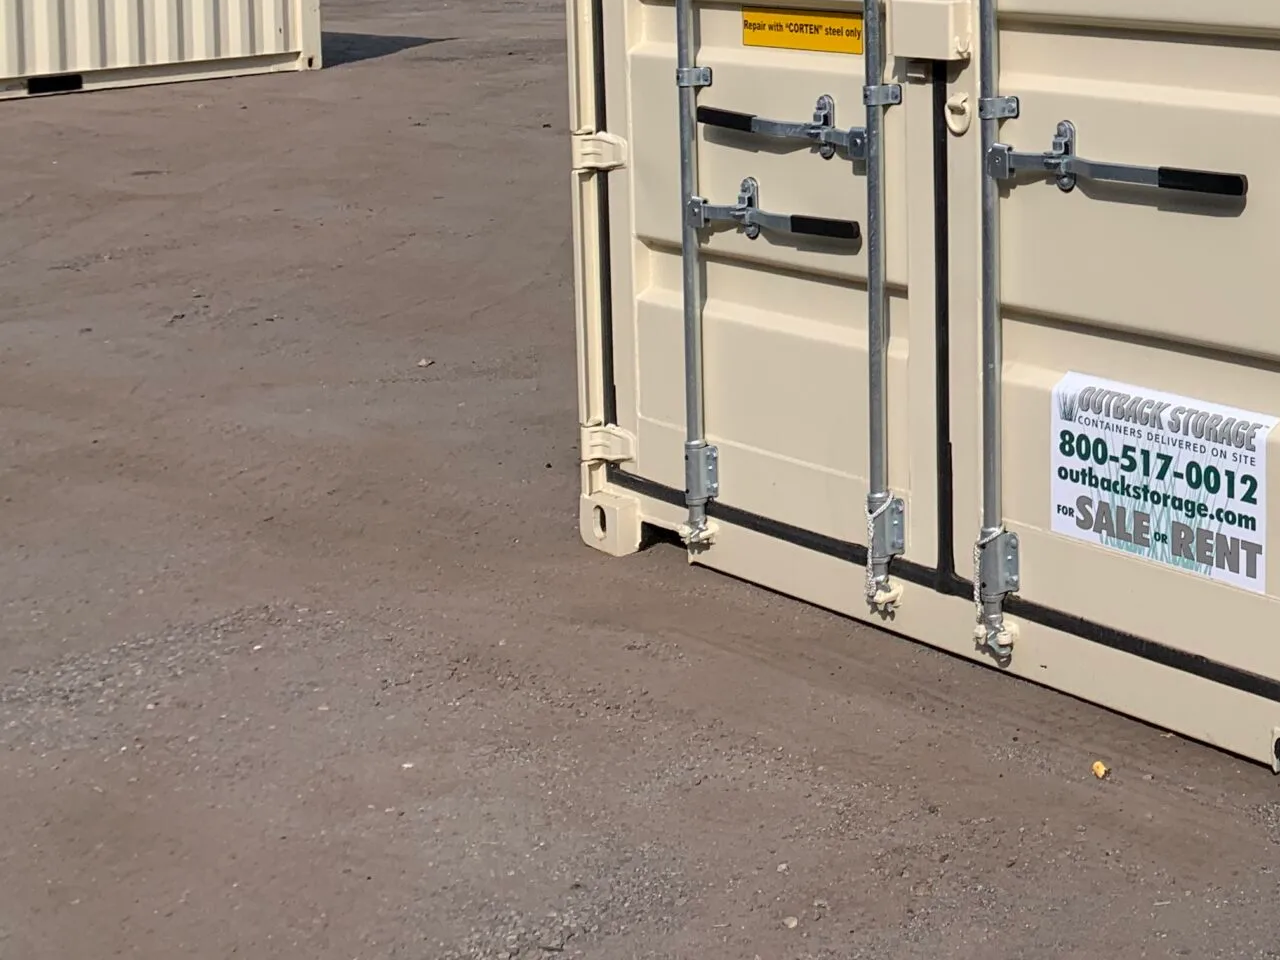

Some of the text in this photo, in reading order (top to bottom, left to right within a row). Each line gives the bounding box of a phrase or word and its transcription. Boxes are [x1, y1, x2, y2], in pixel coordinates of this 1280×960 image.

[743, 19, 766, 32] Repair
[768, 22, 783, 33] with
[825, 26, 844, 37] steel
[846, 28, 862, 40] only
[1077, 386, 1263, 452] OUTBACK STORAGE
[1078, 415, 1257, 467] CONTAINERS DELIVERED ON SITE
[1058, 466, 1257, 531] outbackstorage.com
[1059, 430, 1258, 505] 800-517-0012
[1057, 495, 1263, 580] FOR SALE OR RENT
